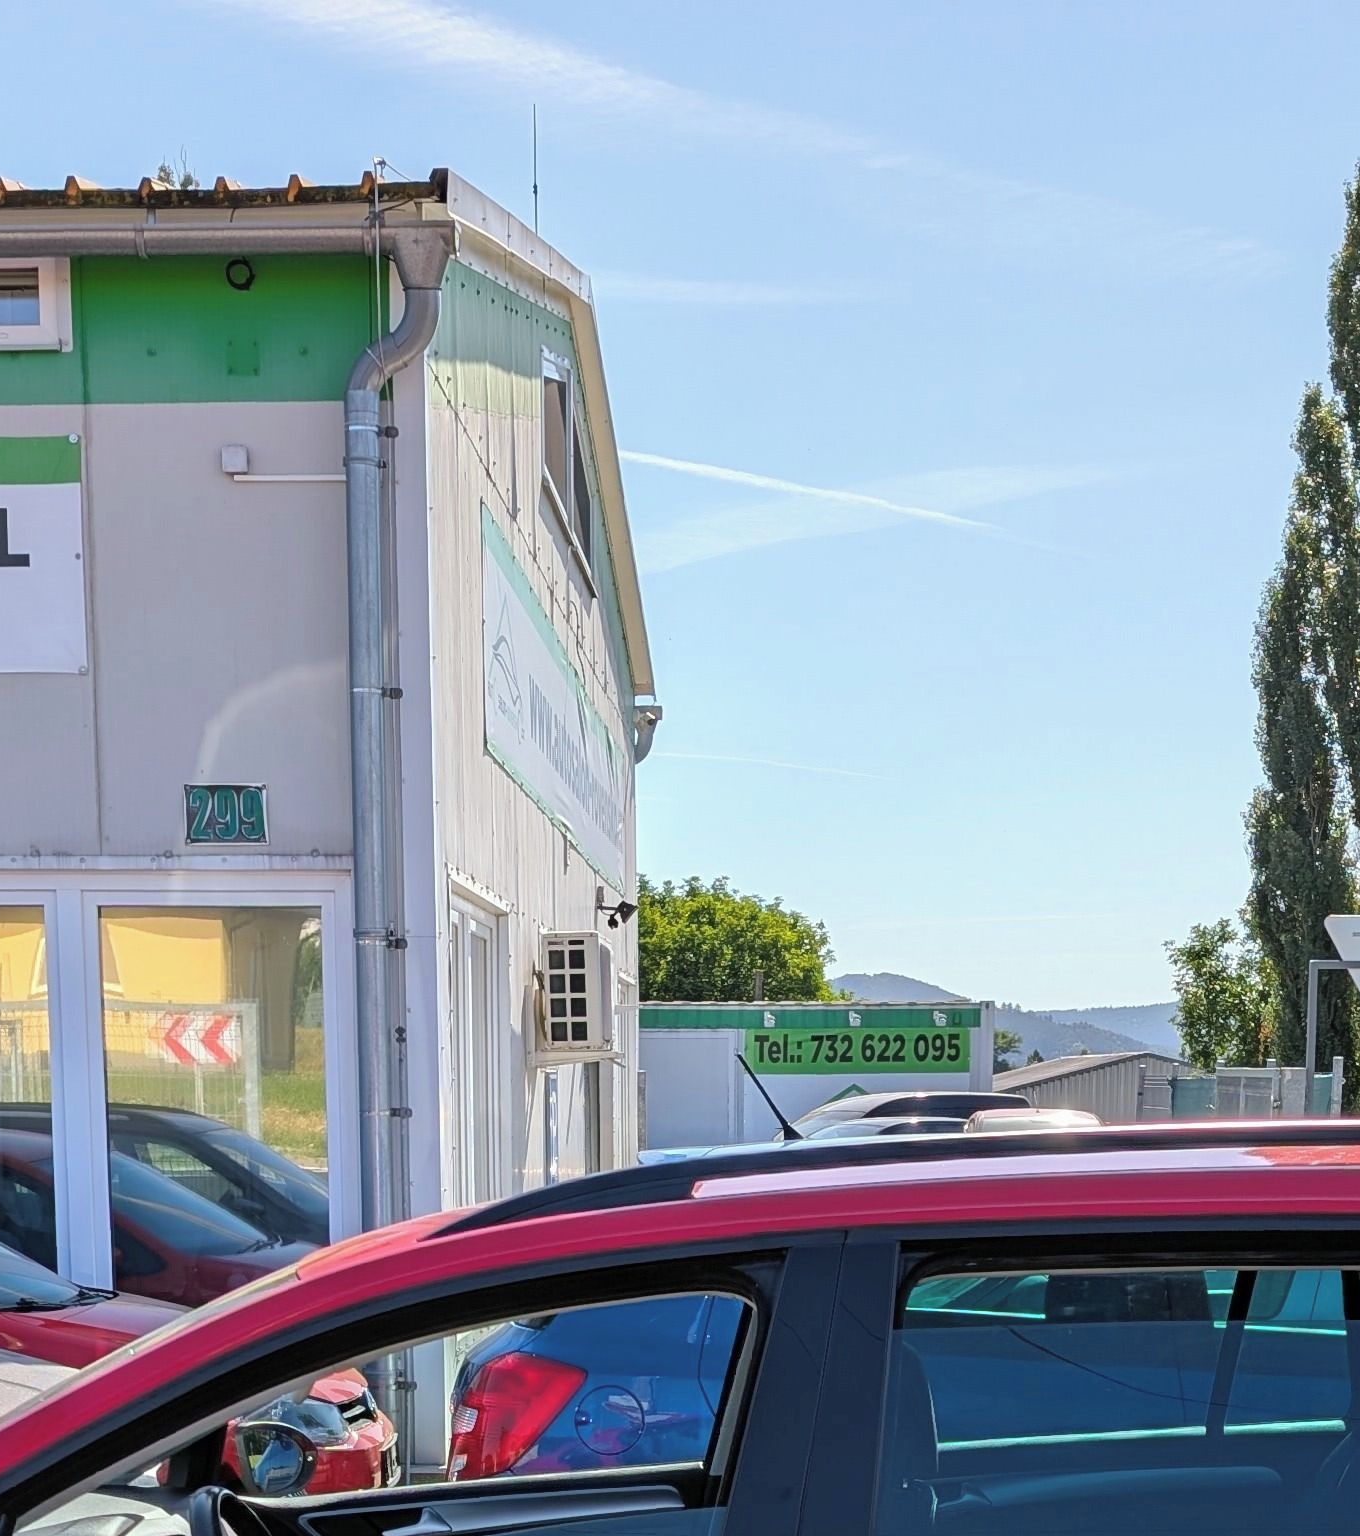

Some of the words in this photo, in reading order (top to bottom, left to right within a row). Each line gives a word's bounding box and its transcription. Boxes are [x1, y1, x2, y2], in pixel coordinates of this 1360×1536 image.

[190, 787, 265, 840] 299
[754, 1034, 802, 1063] Tel.:
[811, 1034, 853, 1063] 732
[861, 1034, 906, 1063] 622
[913, 1033, 961, 1062] 095
